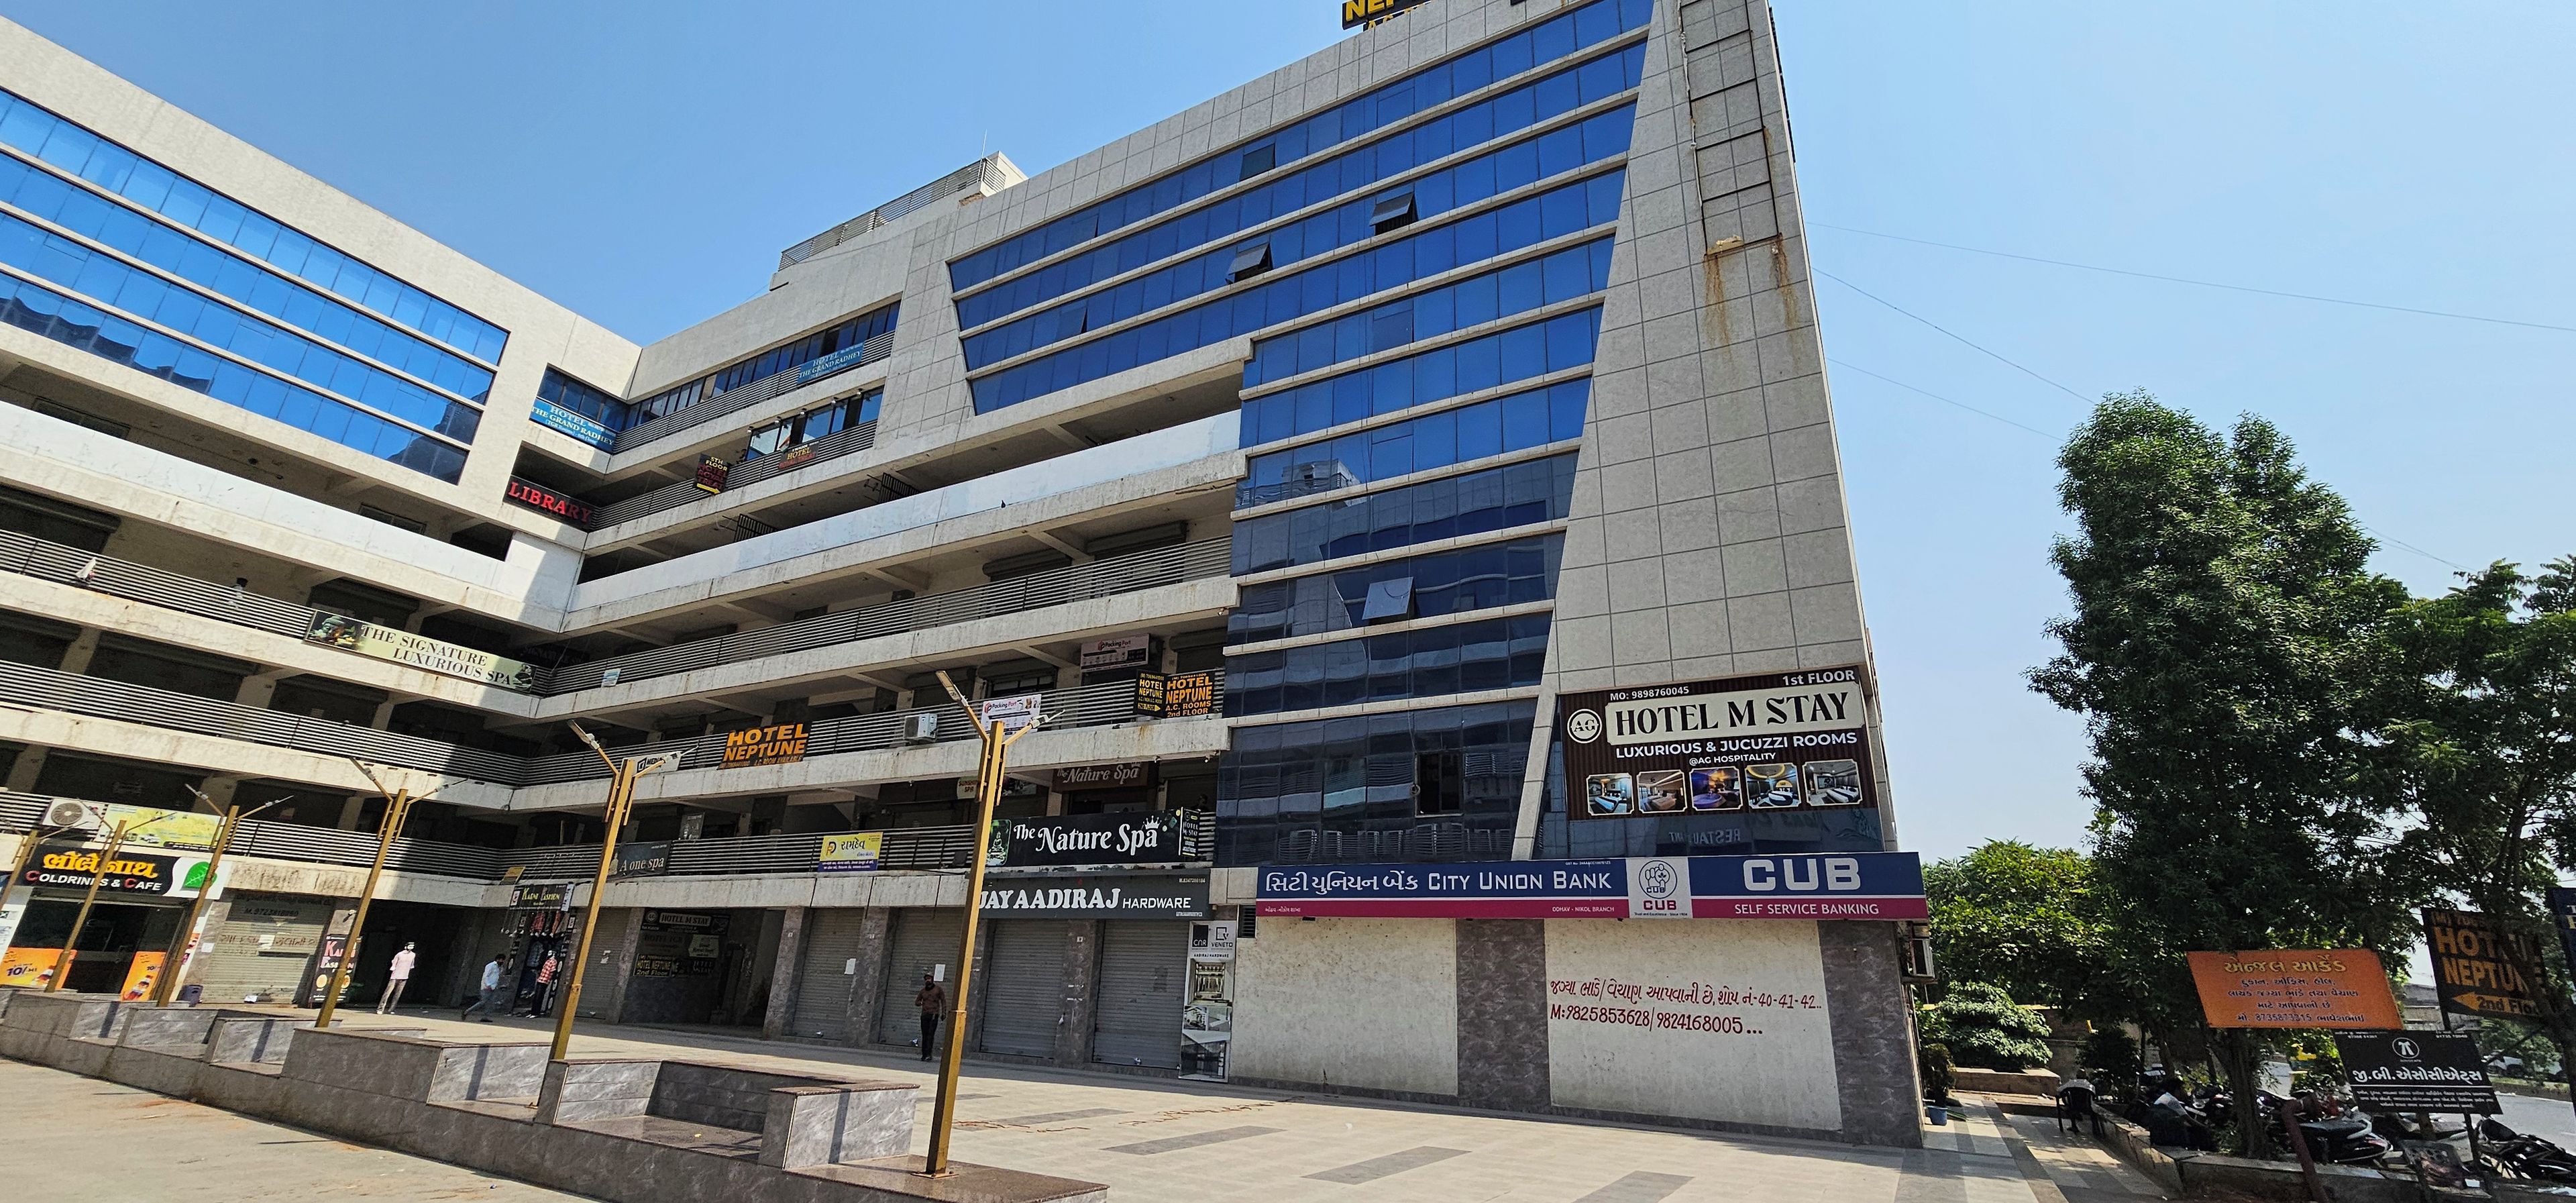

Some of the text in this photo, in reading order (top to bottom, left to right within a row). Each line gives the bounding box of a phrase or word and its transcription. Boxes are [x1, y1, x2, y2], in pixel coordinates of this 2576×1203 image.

[813, 352, 839, 367] HOTEL
[532, 407, 548, 417] THE
[549, 415, 580, 431] GRAND
[580, 426, 614, 445] RADHEY
[550, 406, 586, 427] HOTEL
[787, 447, 811, 460] HOTEL
[706, 460, 727, 471] FLOOR
[508, 482, 590, 523] LIBRARY
[361, 625, 487, 666] THE SIGNATURE
[393, 648, 512, 685] LUXURIOUS SPA
[1140, 679, 1163, 690] HOTEL
[1167, 676, 1213, 690] HOTEL
[1782, 670, 1856, 686] 1st FLOOR
[1139, 688, 1162, 698] NEPTUNE
[1166, 686, 1212, 704] NEPTUNE
[1610, 686, 1689, 701] MO: 9898760045
[1183, 700, 1212, 709] ROOMS
[1615, 692, 1848, 736] HOTEL M STAY
[727, 724, 808, 746] HOTEL
[723, 739, 806, 762] NEPTUNE
[1616, 732, 1858, 758] LUXURIOUS & JUCUZZI ROOMS
[1689, 752, 1776, 766] @AG HOSPITALITY
[1063, 768, 1110, 784] Nature
[1114, 765, 1139, 784] Spa
[1014, 824, 1035, 840] The
[1035, 826, 1112, 853] Nature
[1116, 824, 1157, 855] Spa
[619, 857, 664, 872] A one spa
[1743, 857, 1861, 891] CUB
[111, 879, 120, 887] &
[124, 878, 162, 891] CAFE
[1266, 870, 1418, 895] સિટી યુનિયન બેંક
[1013, 888, 1120, 909] AADIRAJ
[1122, 897, 1191, 908] HARDWARE
[1644, 900, 1676, 910] CUB
[1735, 903, 1880, 914] SELF SERVICE BANKING
[2434, 926, 2527, 961] HOT
[1646, 982, 1699, 1004] આપવાની
